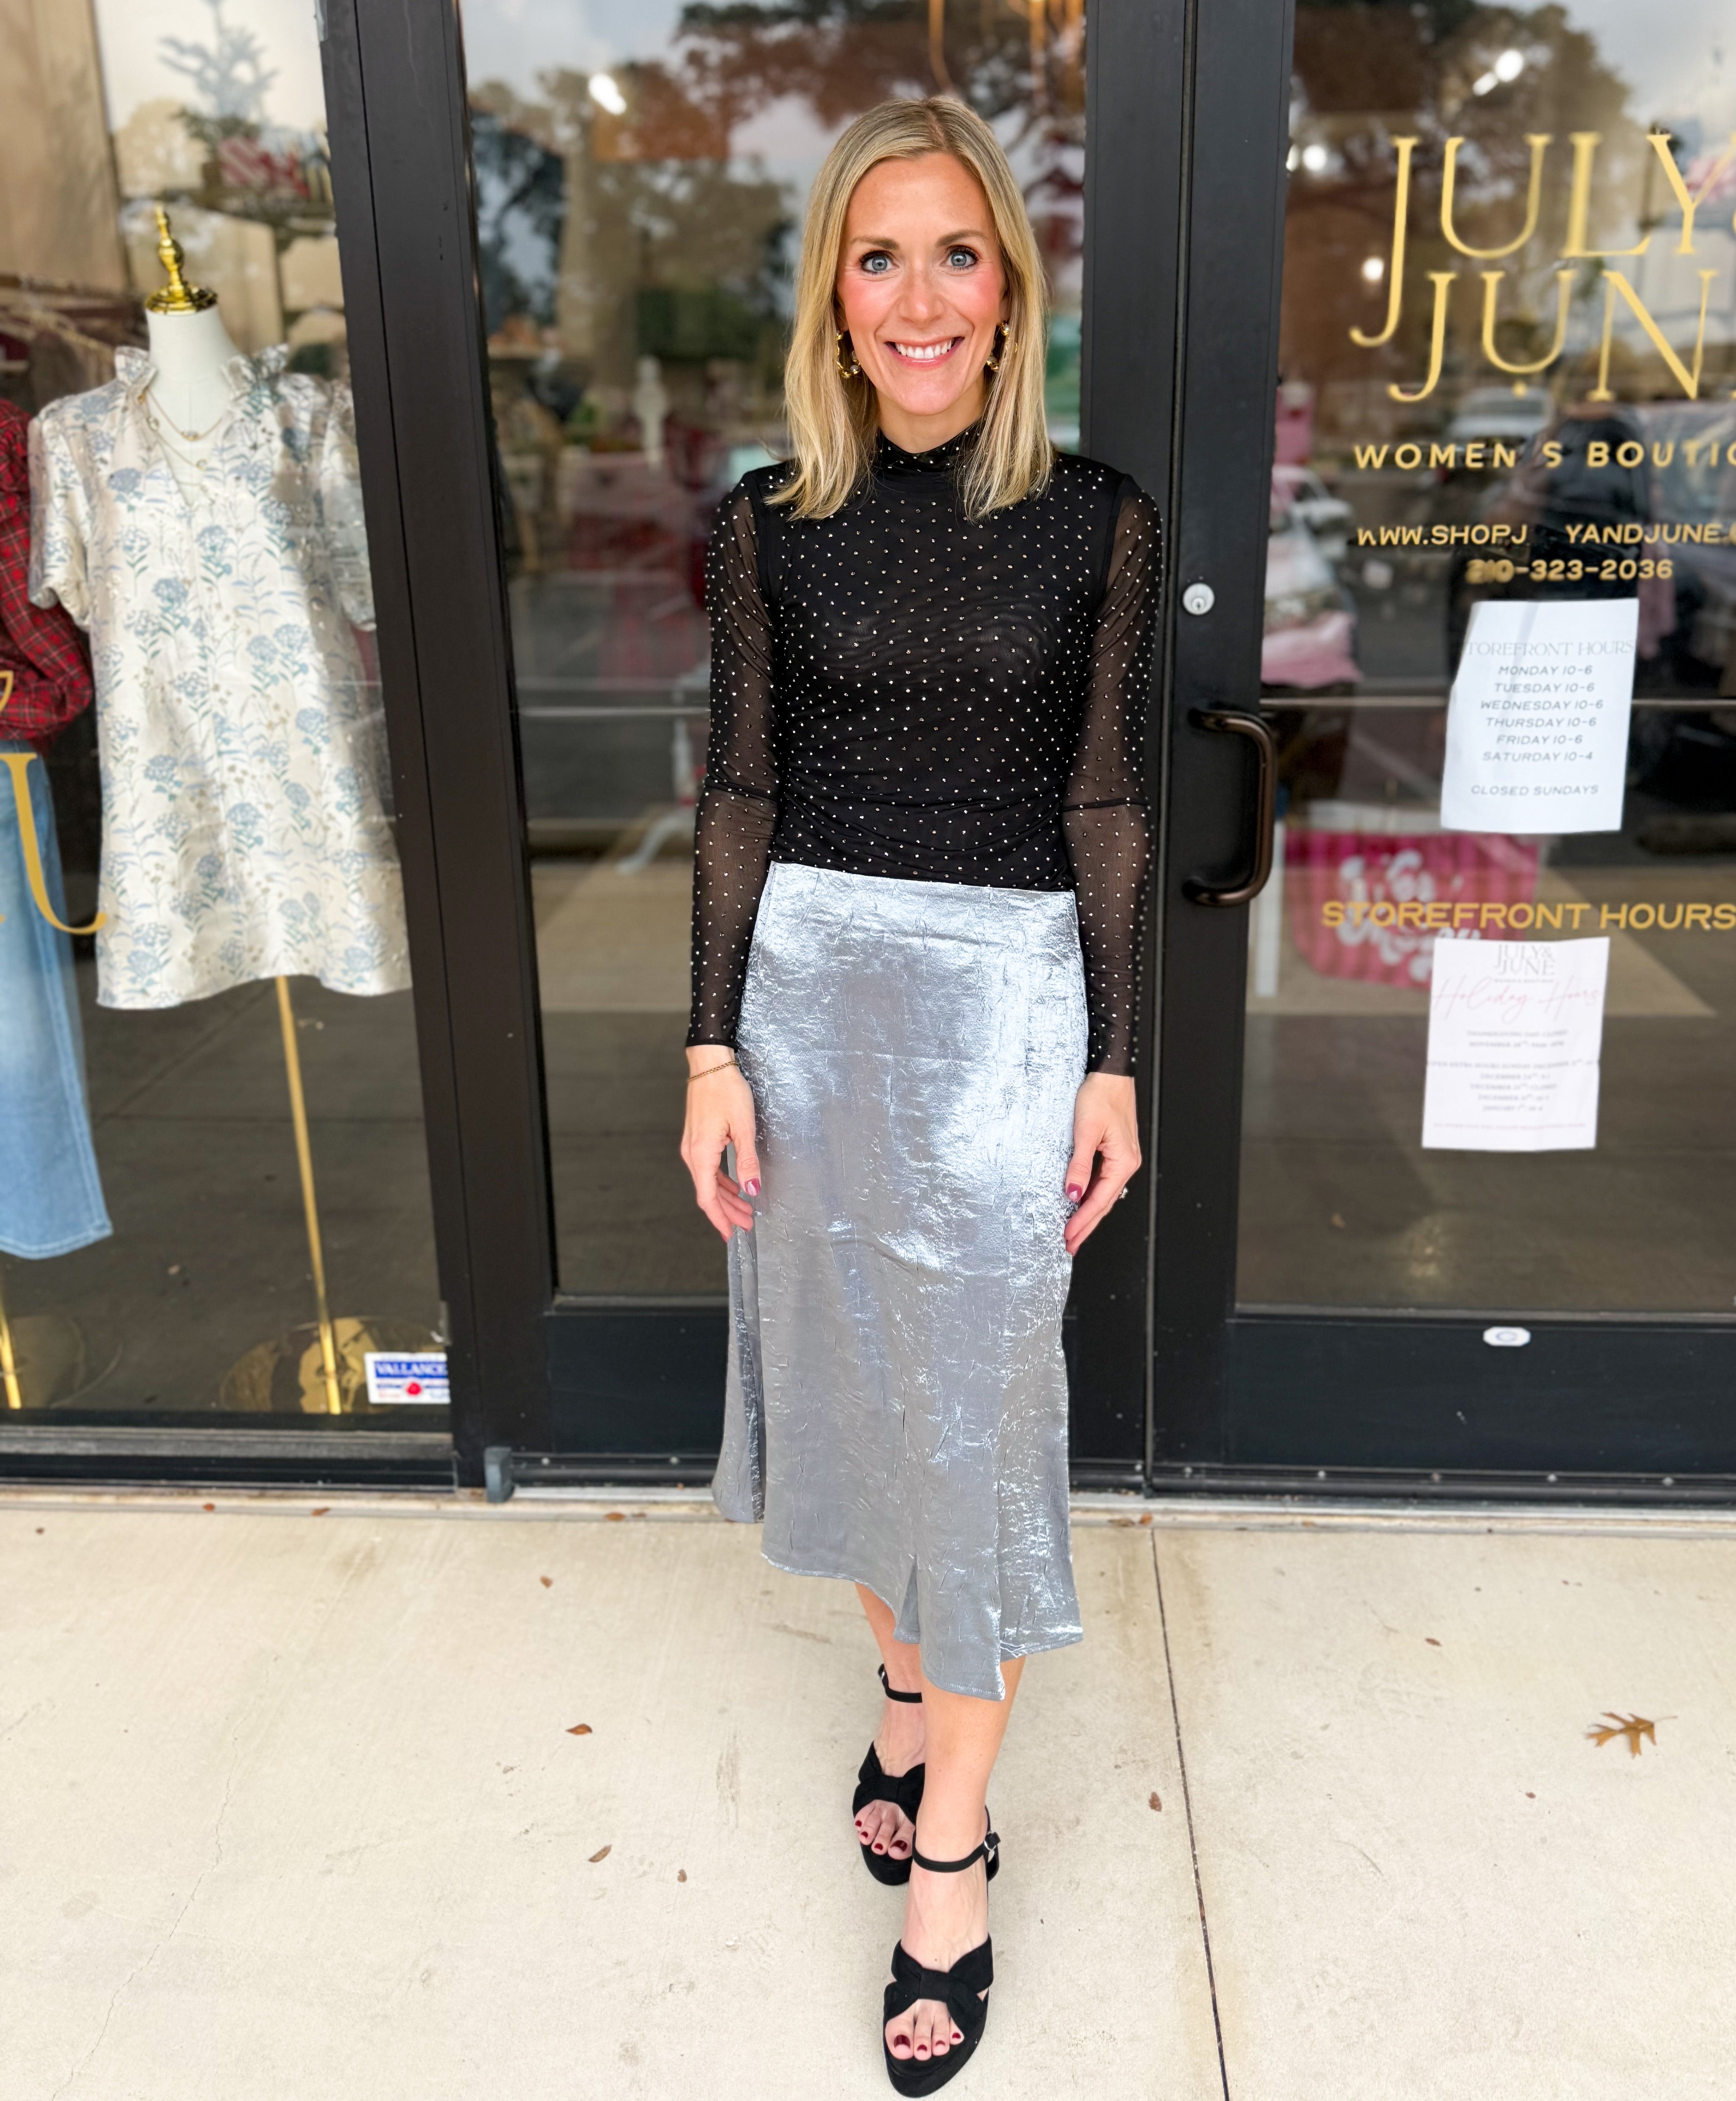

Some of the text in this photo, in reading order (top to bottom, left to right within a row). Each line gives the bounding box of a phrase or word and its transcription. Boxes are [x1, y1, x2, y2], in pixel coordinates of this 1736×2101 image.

[1350, 132, 1736, 347] JULY
[1388, 270, 1736, 401] JUN
[1468, 640, 1633, 657] TOREFRONT HOURS
[1498, 665, 1593, 676] MONDAY 10-6
[1494, 682, 1595, 693] TUESDAY 10-6
[1480, 699, 1604, 710] WEDNESDAY 10-6
[1486, 717, 1597, 728] THURSDAY 10-6
[1496, 734, 1583, 745] FRIDAY 10-6
[1482, 751, 1593, 762] SATURDAY 10-4
[1471, 784, 1599, 796] CLOSED SUNDAYS
[1322, 900, 1736, 930] STOREFRONT HOURS
